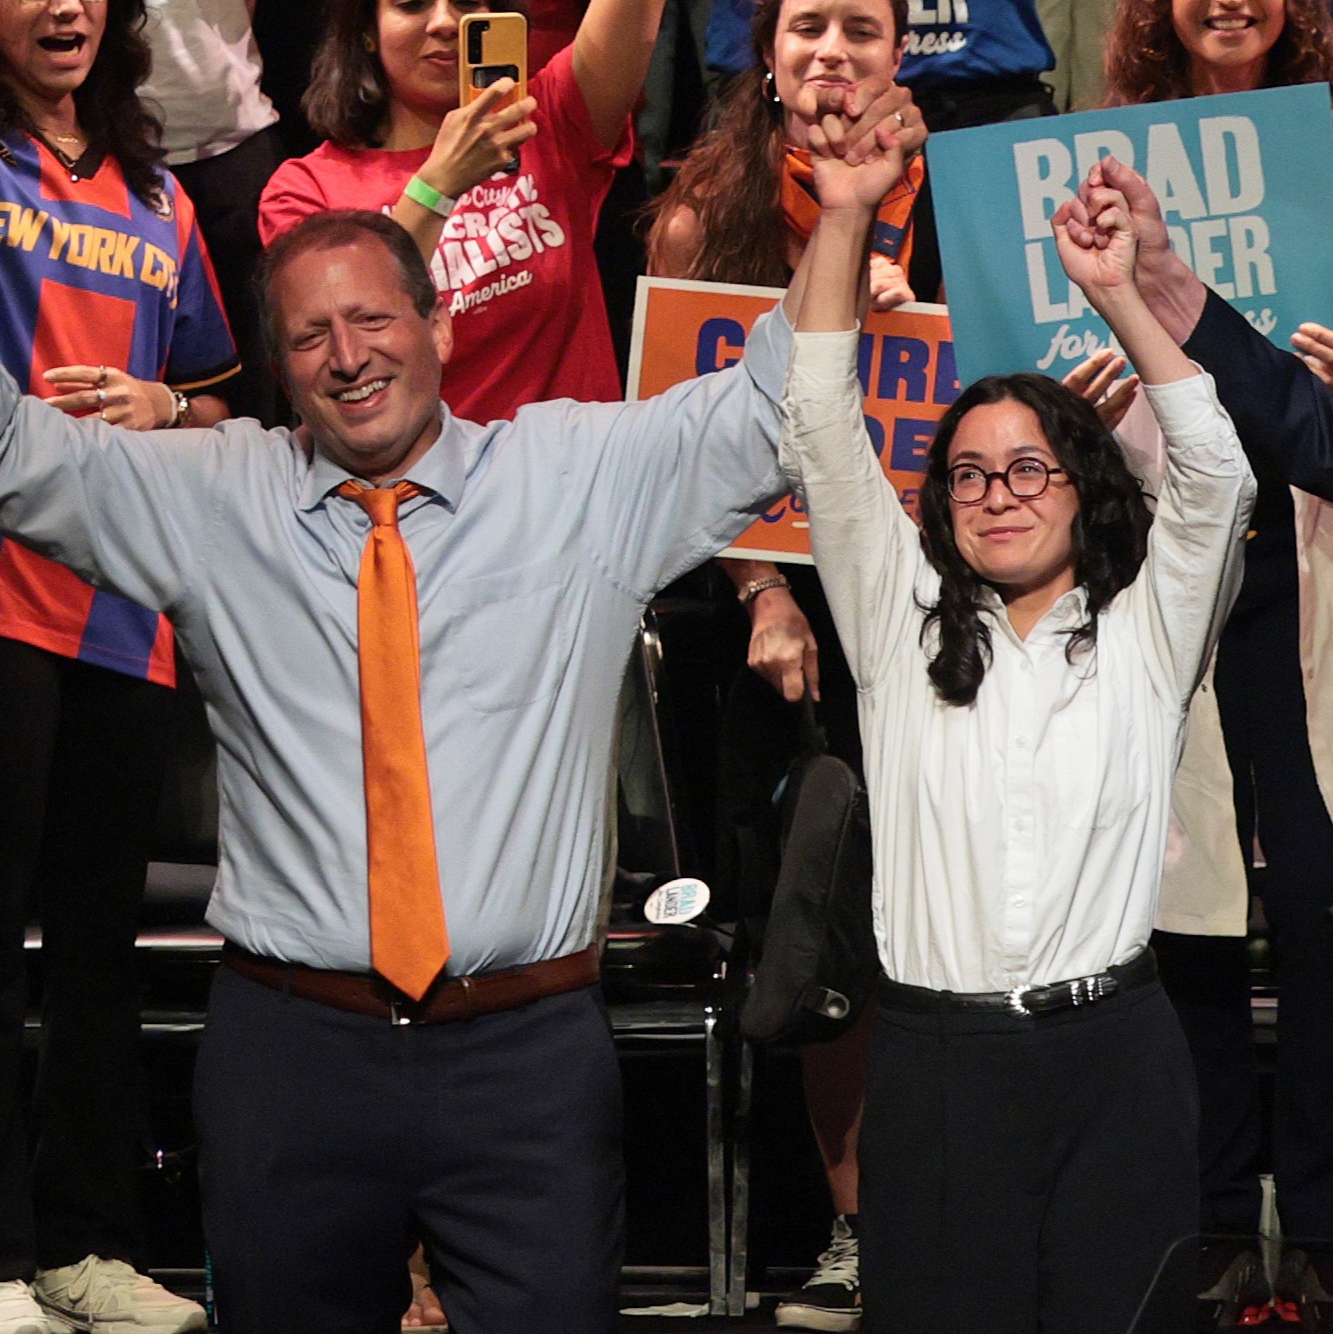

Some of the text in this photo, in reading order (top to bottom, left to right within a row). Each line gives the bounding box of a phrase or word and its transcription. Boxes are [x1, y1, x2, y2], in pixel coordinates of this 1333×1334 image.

[48, 215, 141, 280] YORK
[430, 202, 566, 292] IALISTS
[448, 269, 533, 318] America
[1036, 323, 1106, 370] for
